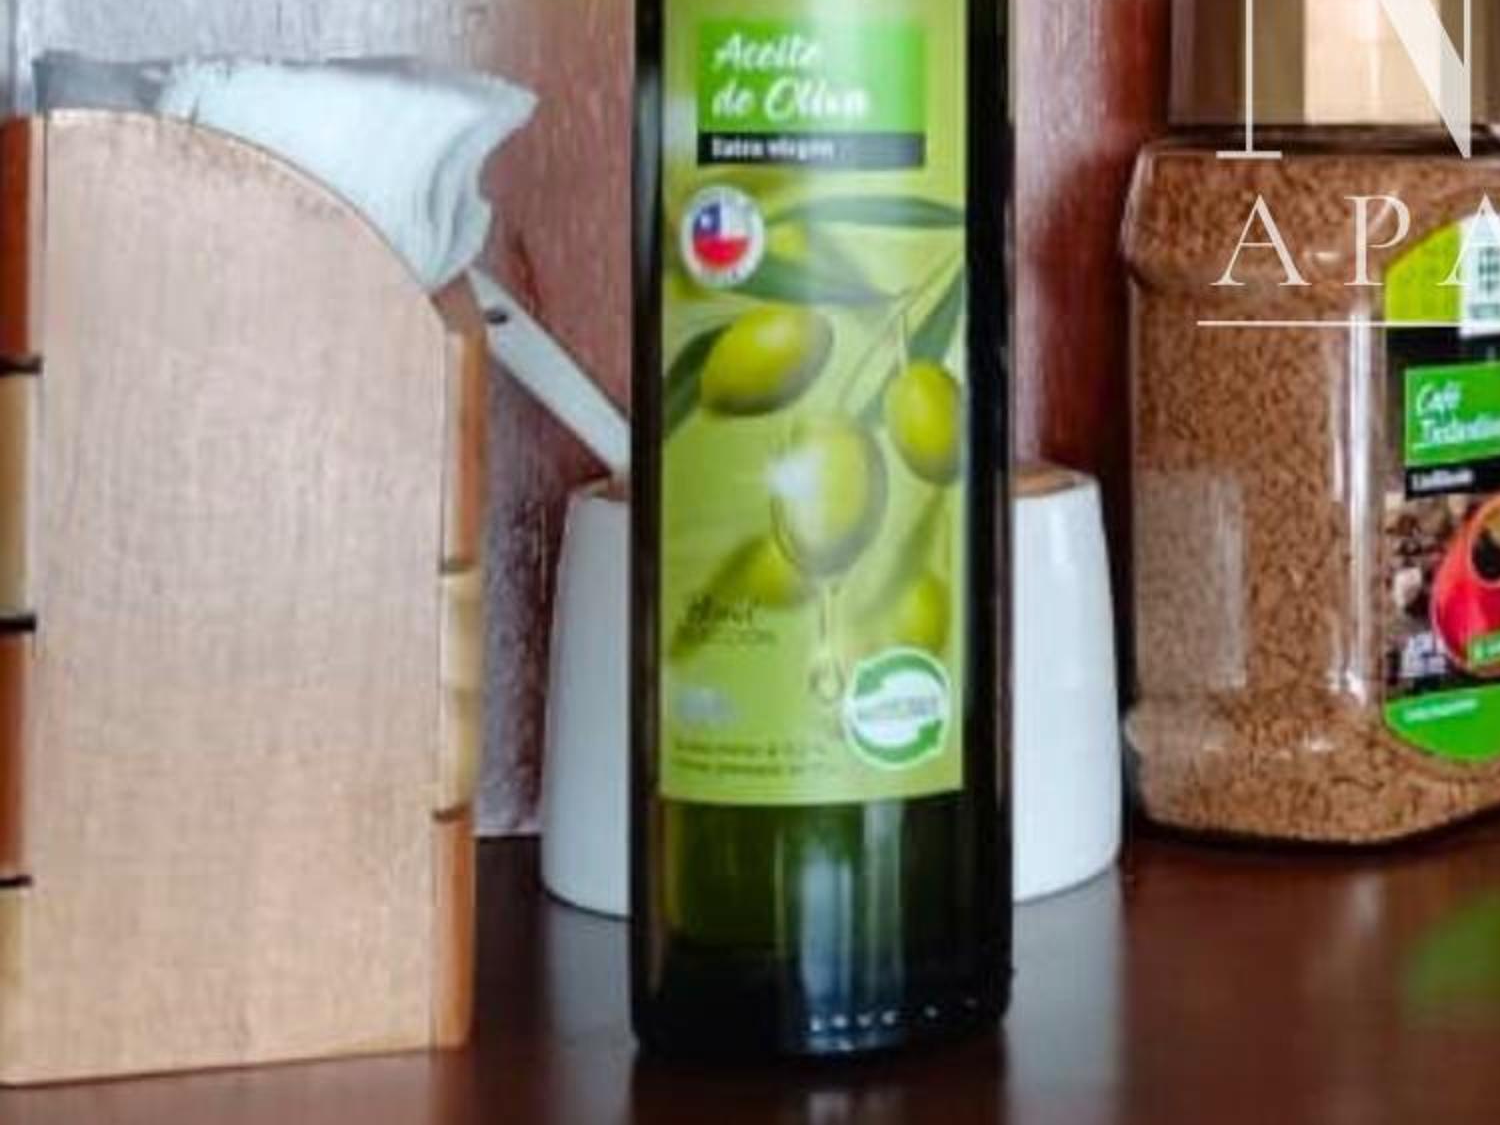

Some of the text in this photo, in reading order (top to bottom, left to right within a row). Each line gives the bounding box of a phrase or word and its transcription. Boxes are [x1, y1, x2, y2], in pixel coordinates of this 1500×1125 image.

[709, 32, 821, 72] Aceite
[711, 77, 870, 122] de Oliva
